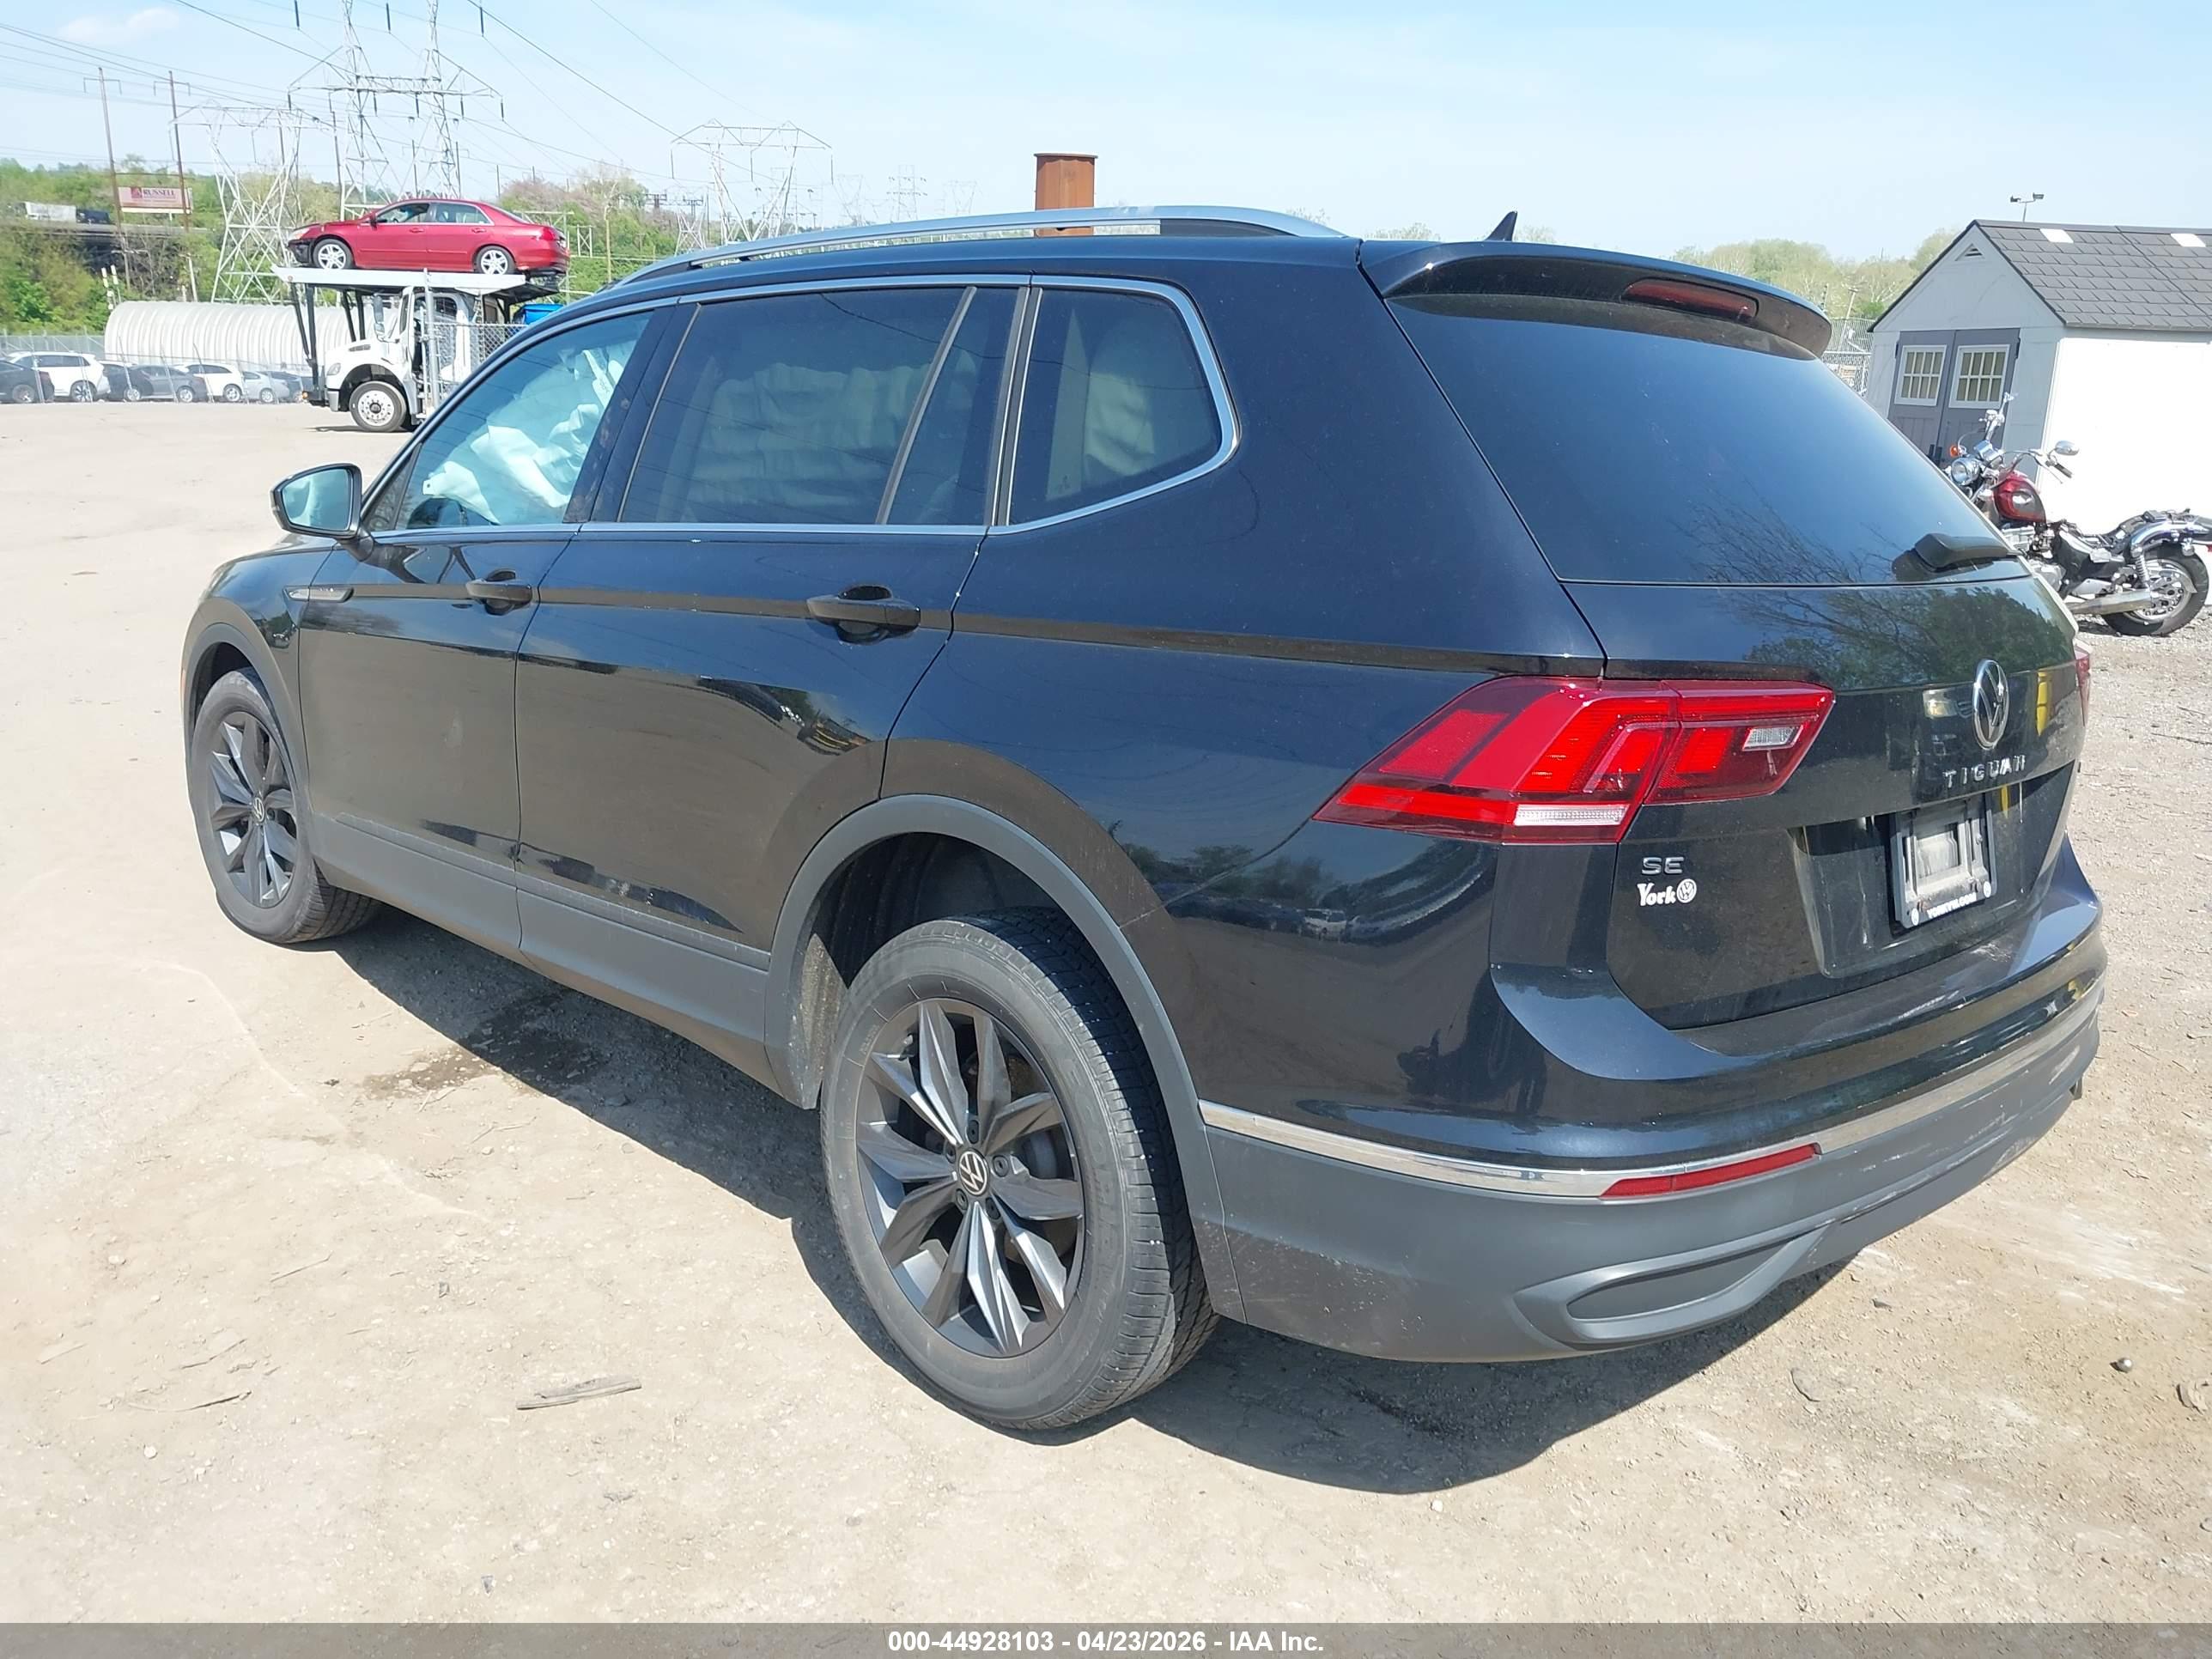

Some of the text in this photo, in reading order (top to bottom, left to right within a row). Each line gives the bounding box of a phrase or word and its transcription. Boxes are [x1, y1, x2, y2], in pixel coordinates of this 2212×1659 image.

[1942, 755, 2025, 788] TIGUAN
[1641, 856, 1685, 875] SE
[1637, 882, 1677, 906] York
